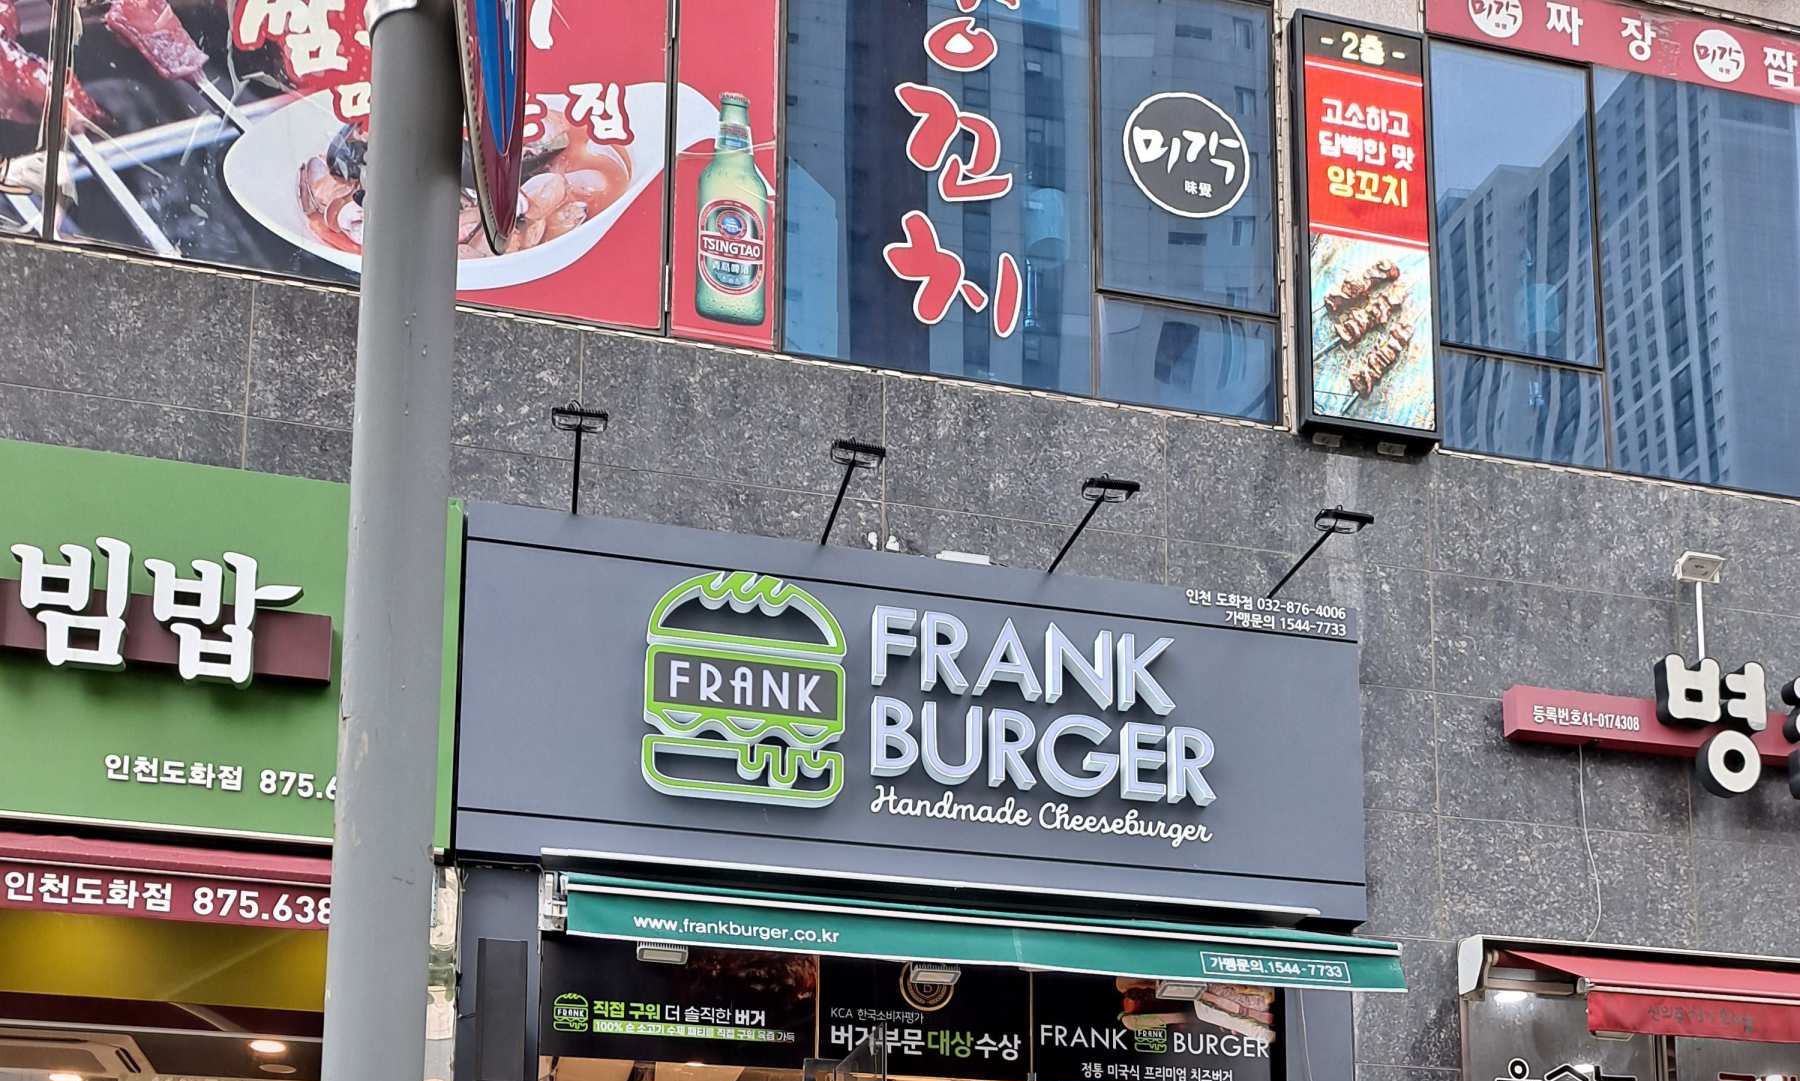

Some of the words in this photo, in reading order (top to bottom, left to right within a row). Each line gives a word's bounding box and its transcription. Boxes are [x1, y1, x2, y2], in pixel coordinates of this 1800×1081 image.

[1695, 43, 1742, 73] 미각
[569, 82, 628, 140] 집
[1321, 97, 1411, 138] 고소하고
[1133, 126, 1241, 185] 미각
[1319, 130, 1387, 167] 담백한
[1391, 143, 1415, 172] 맛
[1327, 165, 1409, 208] 양꼬치
[702, 236, 761, 259] TSINGTAO
[10, 536, 304, 686] 빔밥
[1185, 588, 1212, 606] 인천
[1215, 593, 1253, 611] 도화점
[1256, 597, 1347, 620] 032-876-4006
[1225, 610, 1276, 630] 가맹문의
[1279, 617, 1347, 637] 1544-7733
[870, 604, 1176, 717] FRANK
[664, 659, 824, 714] FRANK
[870, 694, 1218, 808] BURGER
[104, 753, 244, 792] 인천도화점
[870, 784, 1033, 828] Handmade
[1037, 800, 1214, 849] Cheeseburger
[4, 871, 172, 913] 인천도화점
[633, 914, 840, 944] www.frankburger.co.kr
[556, 1007, 586, 1018] FRANK
[593, 1000, 625, 1019] 직접
[628, 1003, 661, 1021] 구워
[665, 1004, 680, 1022] 더
[683, 1005, 732, 1025] 솔직한
[734, 1009, 766, 1027] 버거
[596, 1020, 623, 1032] 100%
[830, 1007, 853, 1019] KCA
[857, 1008, 925, 1025] 한국소비자평가
[927, 1029, 974, 1058] 대상
[974, 1033, 1022, 1061] 수상
[1040, 1024, 1128, 1051] FRANK
[1137, 1030, 1164, 1039] FRANK
[1173, 1032, 1270, 1059] BURGER
[1080, 1062, 1104, 1079] 정통
[1107, 1064, 1140, 1081] 미국식
